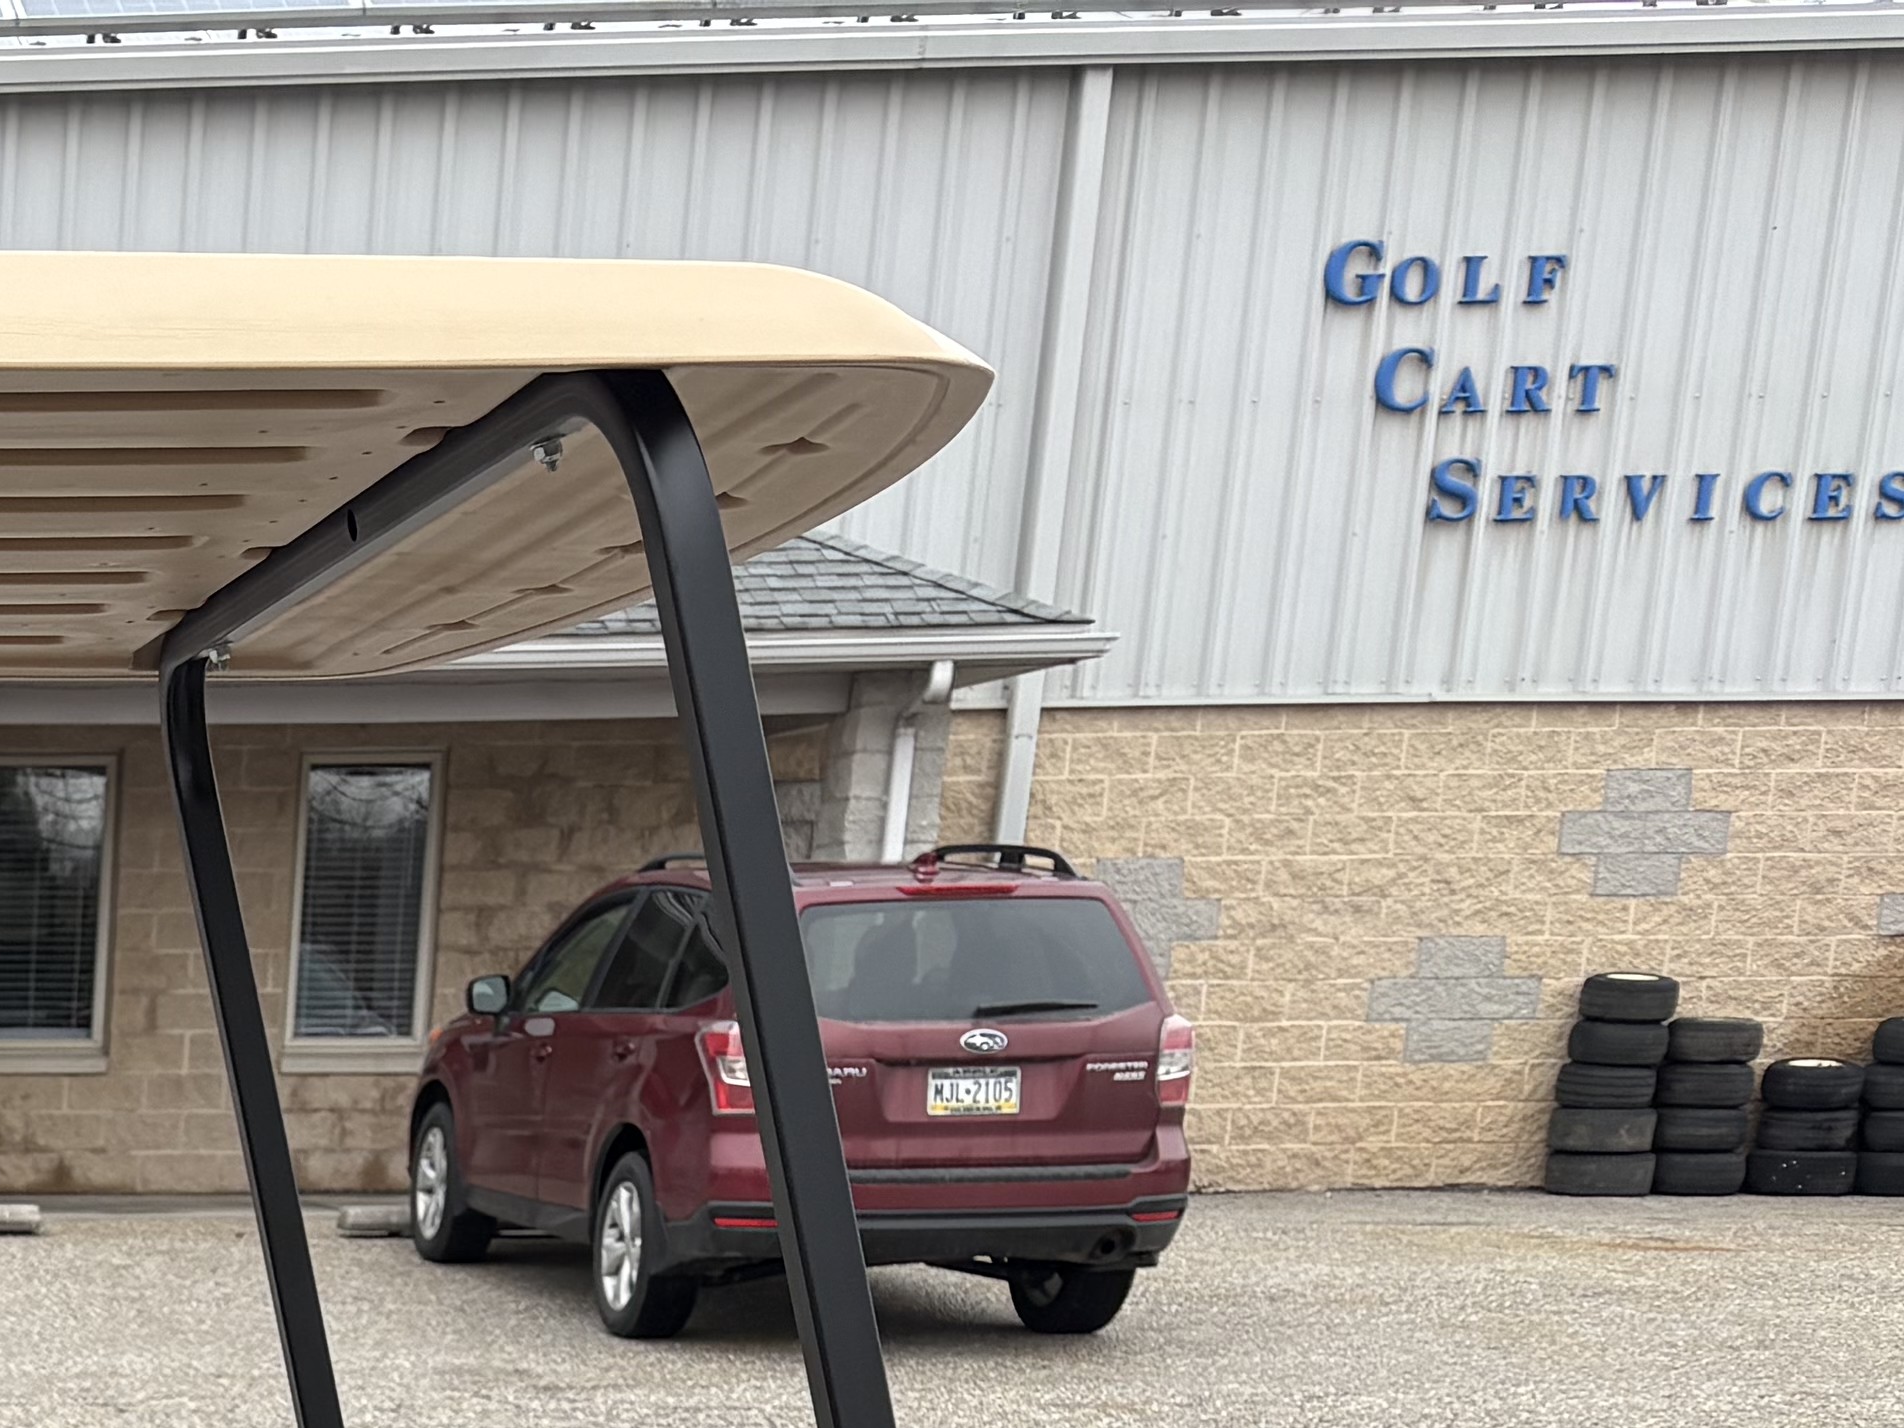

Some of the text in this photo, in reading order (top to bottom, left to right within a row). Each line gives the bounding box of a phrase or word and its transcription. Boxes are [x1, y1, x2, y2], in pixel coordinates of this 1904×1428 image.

[1323, 239, 1569, 307] GOLF
[1374, 346, 1617, 415] CART
[1427, 456, 1904, 523] SERVICES
